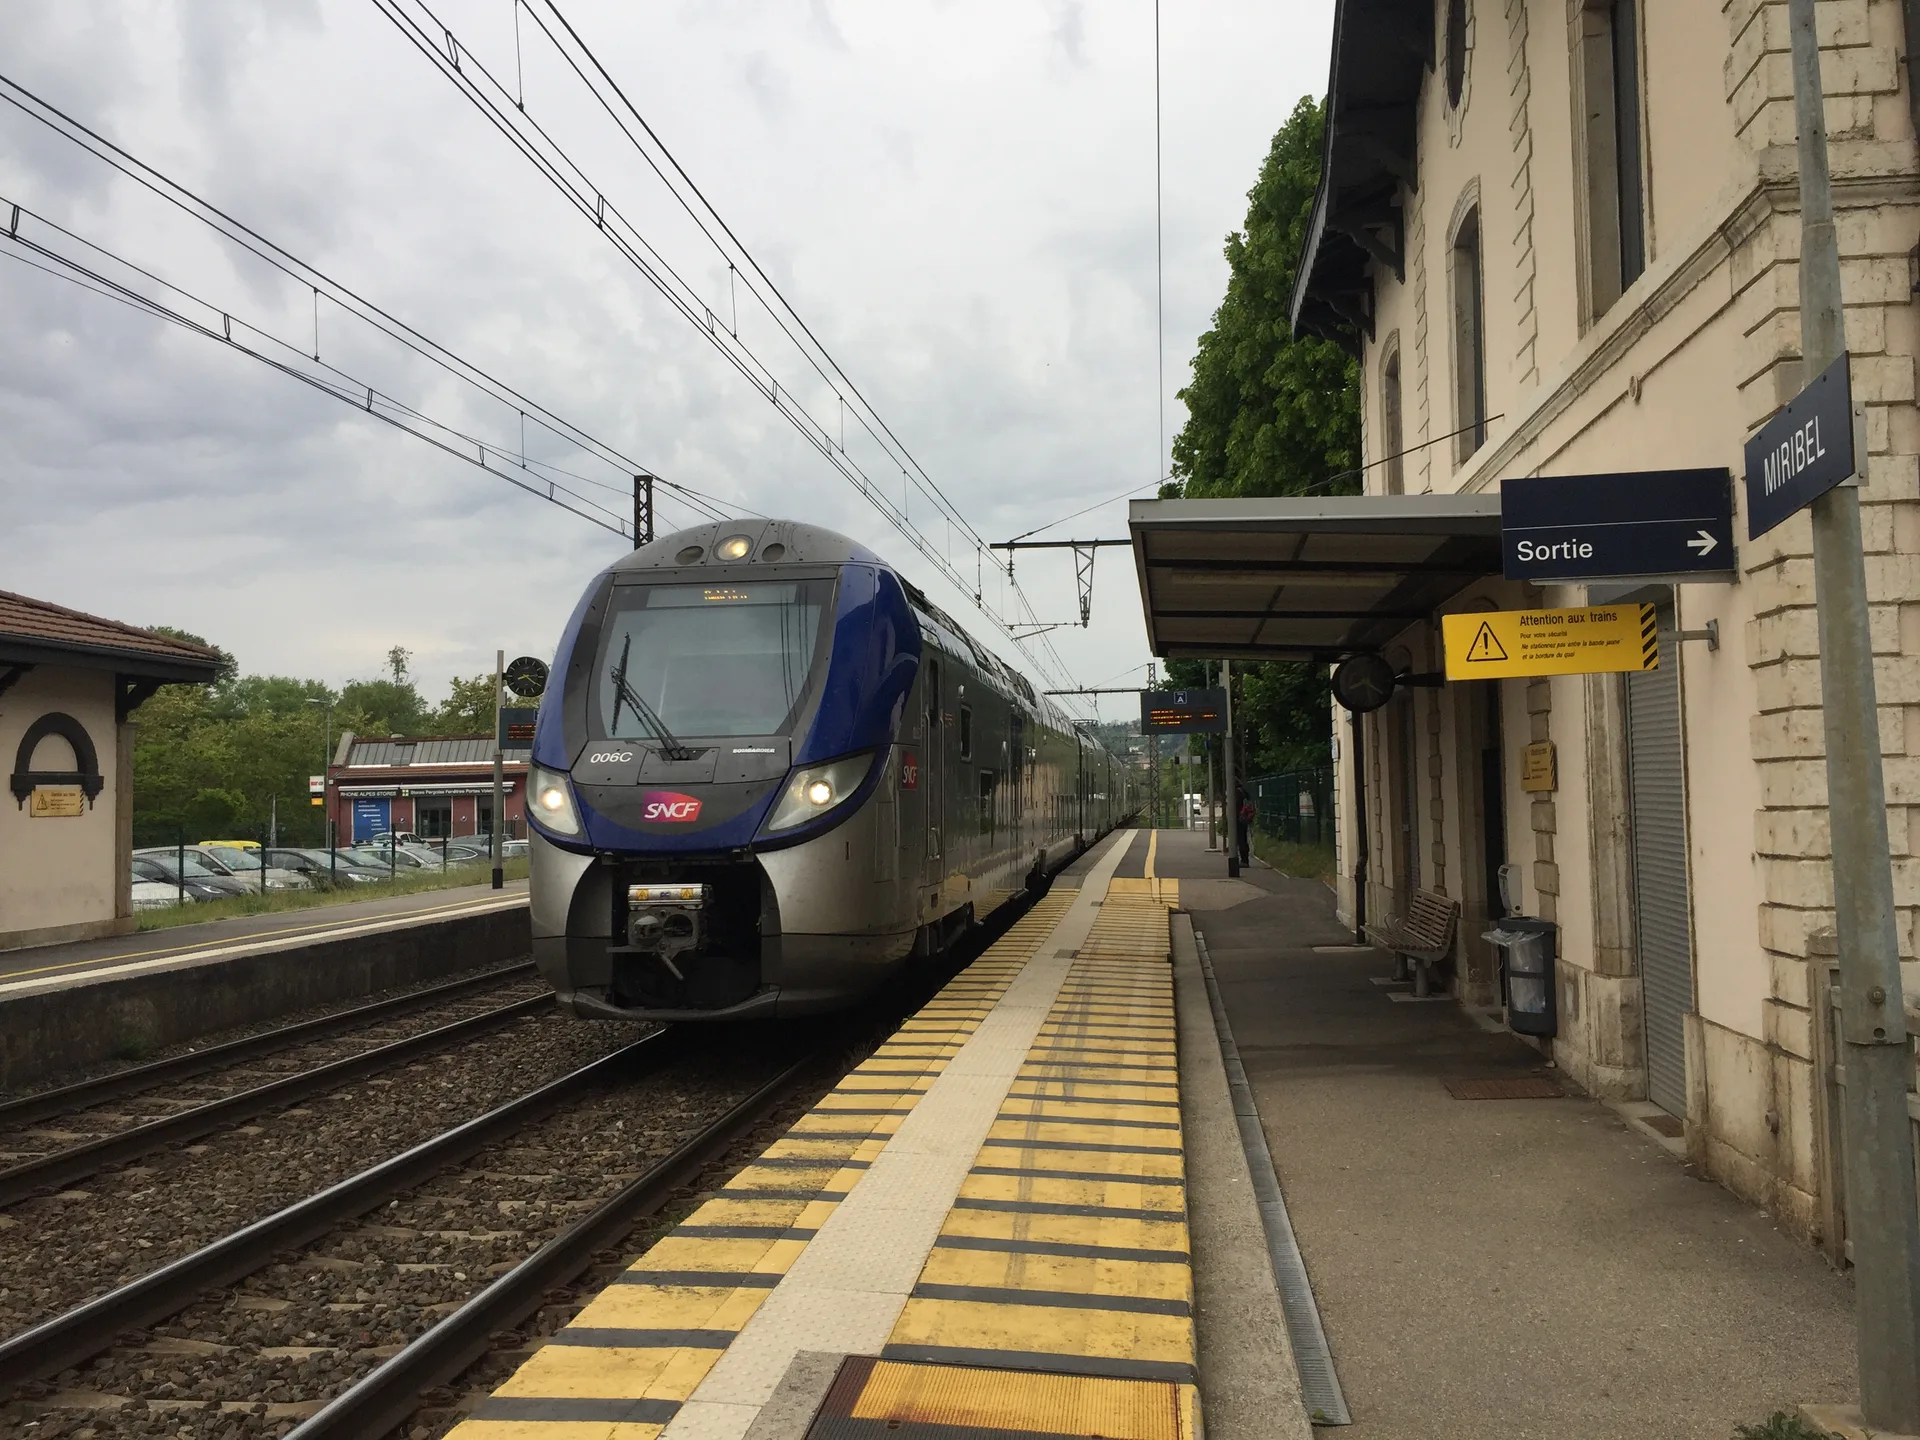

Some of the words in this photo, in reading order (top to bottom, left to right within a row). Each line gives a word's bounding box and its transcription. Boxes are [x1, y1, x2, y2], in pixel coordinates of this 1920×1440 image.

[1763, 415, 1826, 497] MIRIBEL
[1517, 538, 1593, 562] Sortie
[1519, 613, 1564, 627] Attention
[1567, 613, 1586, 624] aux
[1590, 611, 1618, 623] trains
[1548, 630, 1568, 638] sécurité
[1530, 642, 1556, 650] stationnez
[1556, 642, 1566, 650] pas
[1567, 640, 1581, 648] entre
[1582, 639, 1588, 647] la
[1588, 639, 1605, 647] bande
[1605, 638, 1620, 647] jaune
[1535, 652, 1555, 660] bordure
[1564, 651, 1576, 659] quai
[590, 751, 634, 763] 006C
[902, 765, 918, 784] SNCF
[644, 802, 699, 819] SNCF
